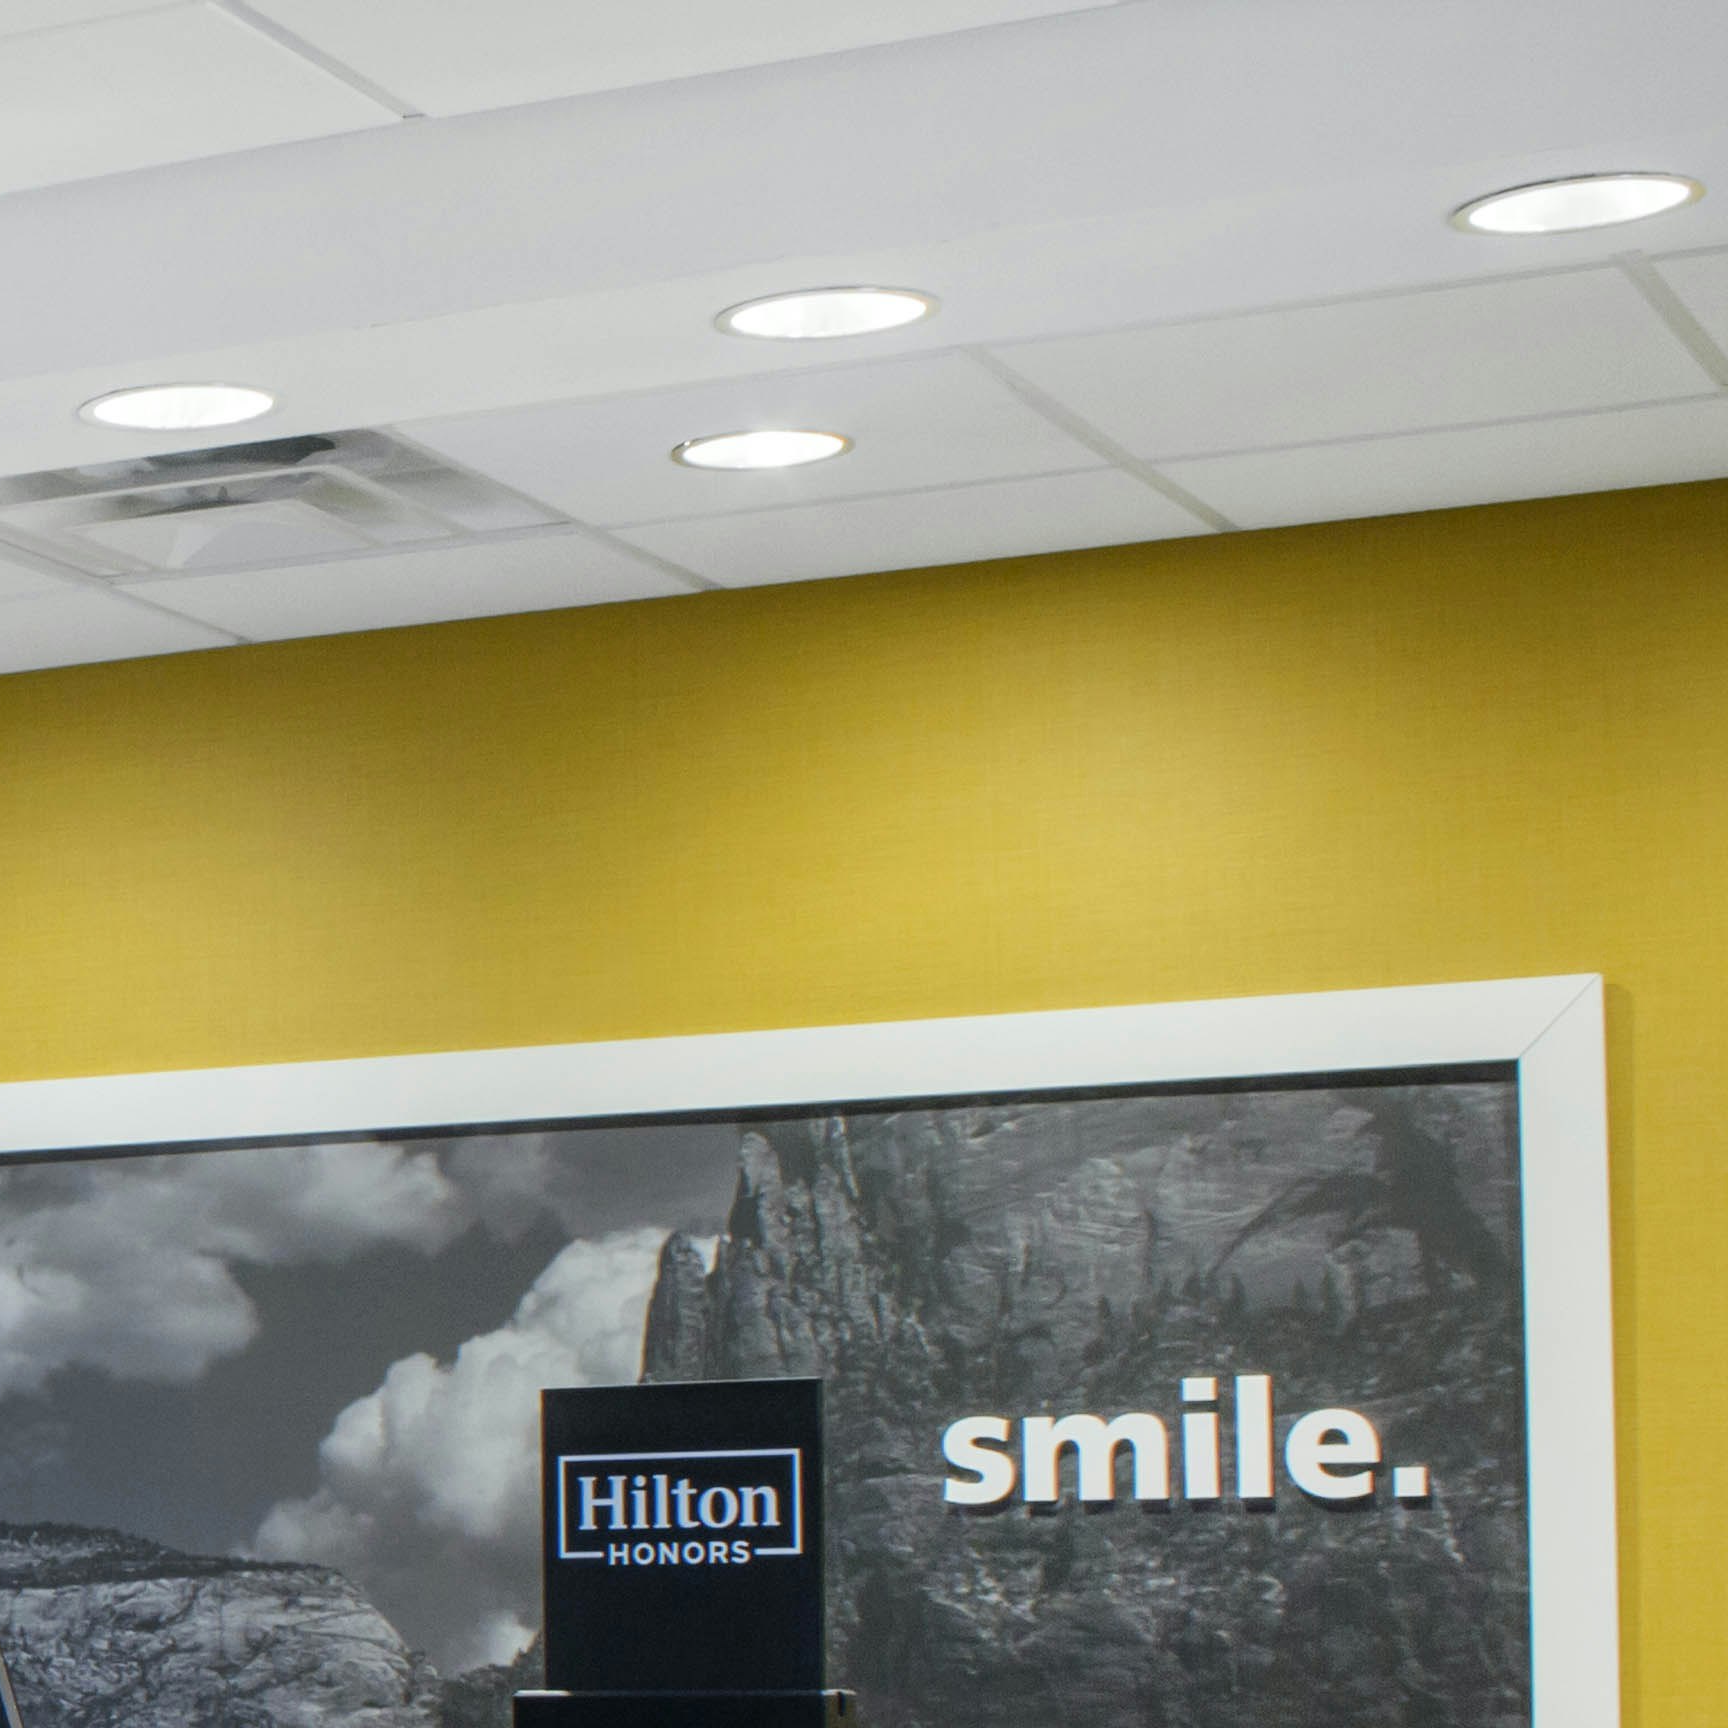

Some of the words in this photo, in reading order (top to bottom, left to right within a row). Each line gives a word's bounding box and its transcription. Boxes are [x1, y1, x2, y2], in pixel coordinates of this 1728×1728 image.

[943, 1374, 1430, 1505] smile.
[577, 1474, 782, 1530] Hilton
[607, 1540, 752, 1566] HONORS
